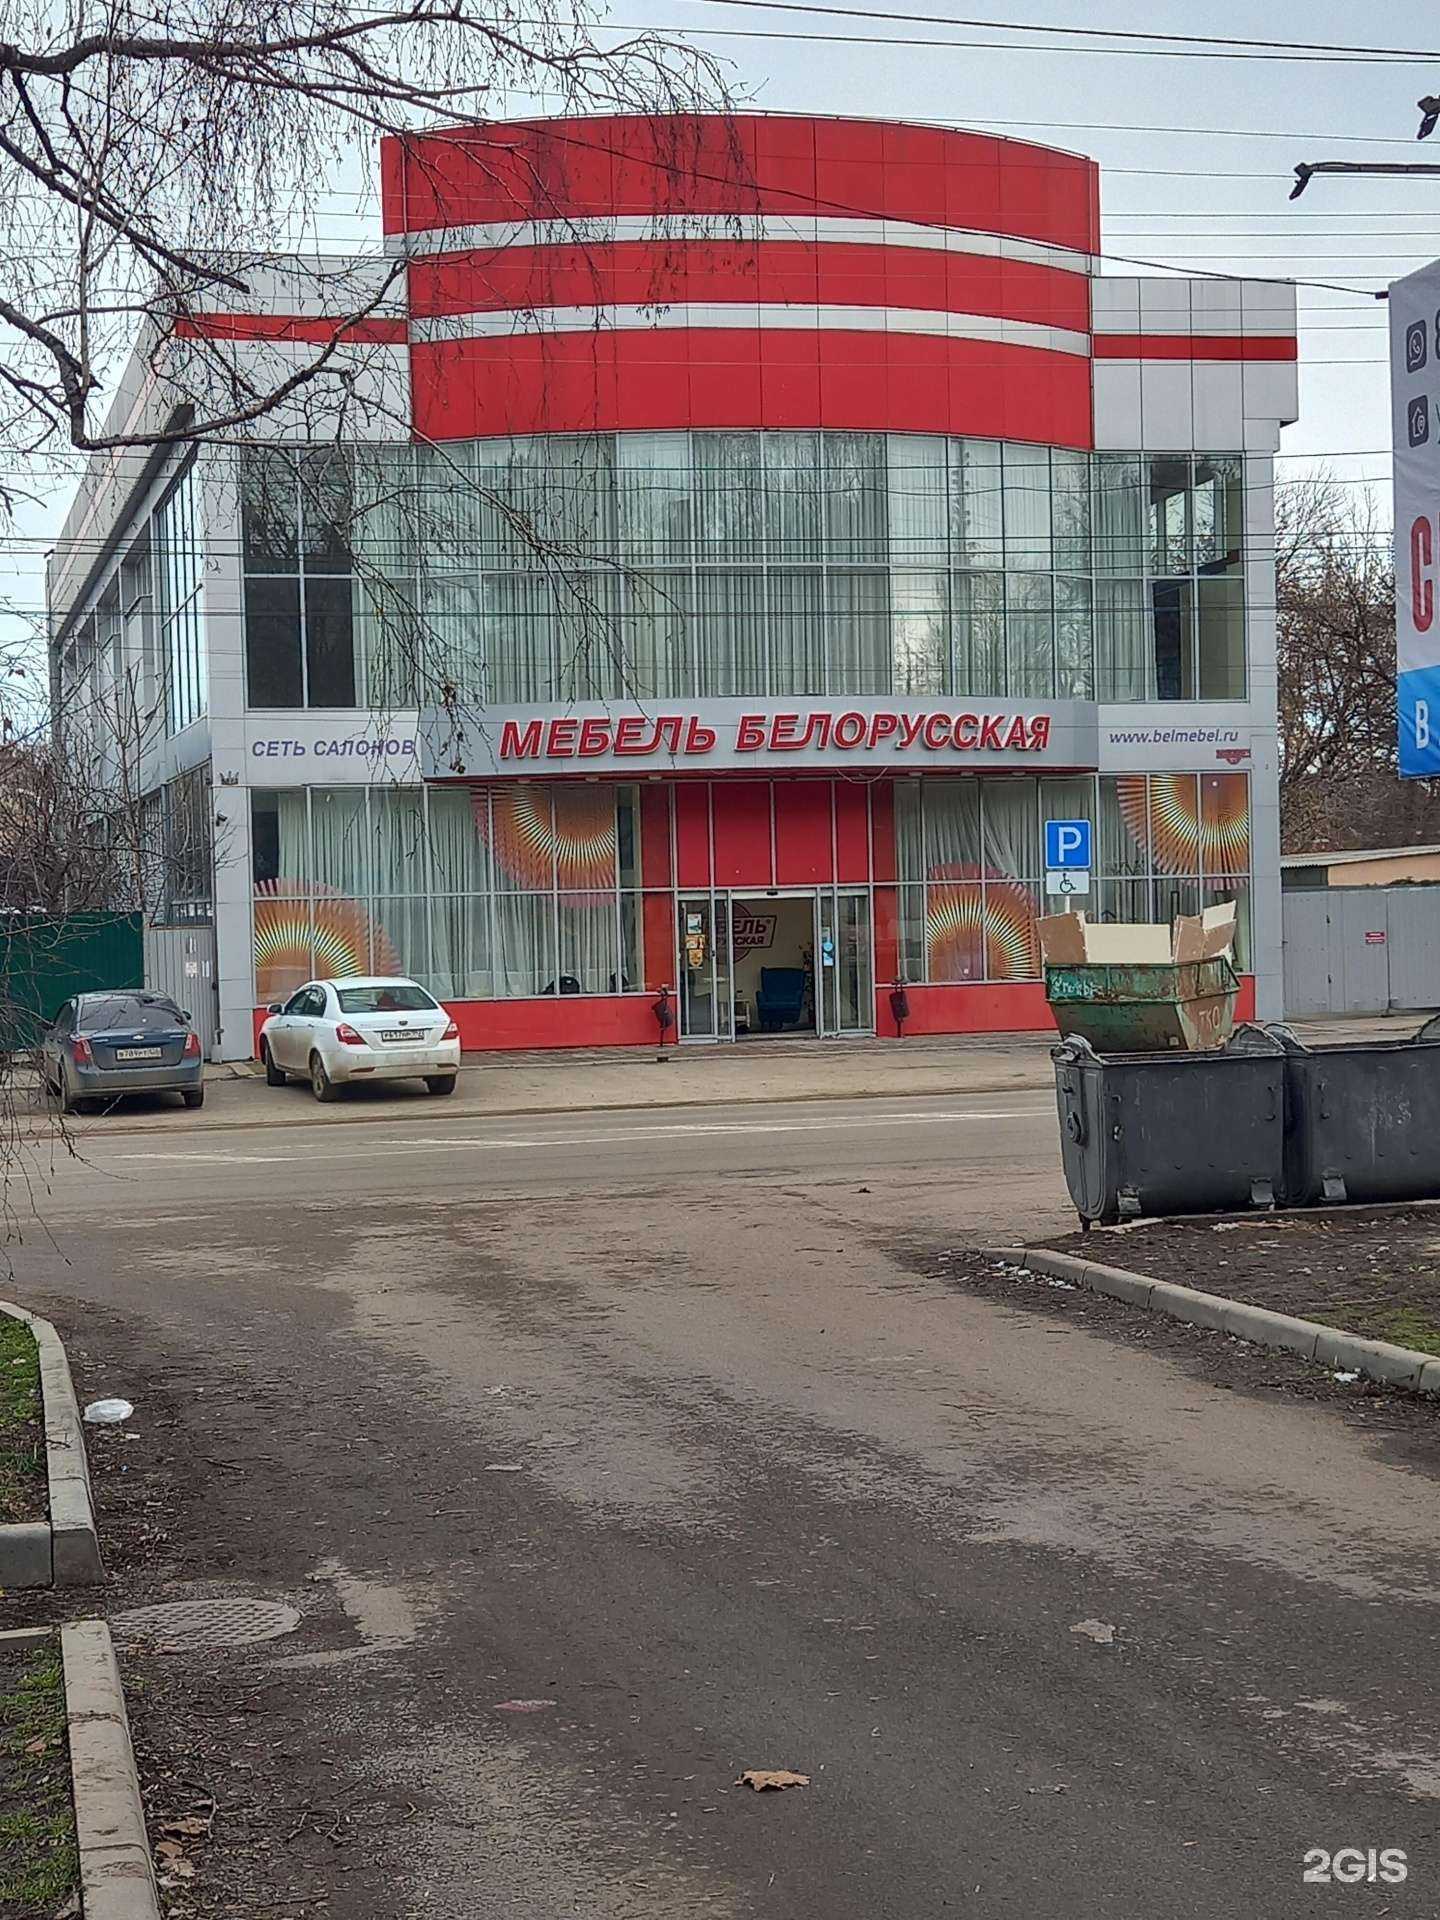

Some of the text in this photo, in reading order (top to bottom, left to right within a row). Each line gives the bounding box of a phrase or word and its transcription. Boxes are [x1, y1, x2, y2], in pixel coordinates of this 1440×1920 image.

[252, 739, 415, 757] СЕТЬ САЛОНОВ
[500, 710, 1051, 760] МЕБЕЛЬ БЕЛОРУССКАЯ
[1109, 728, 1239, 743] www.belmebel.ru
[1058, 826, 1082, 863] P
